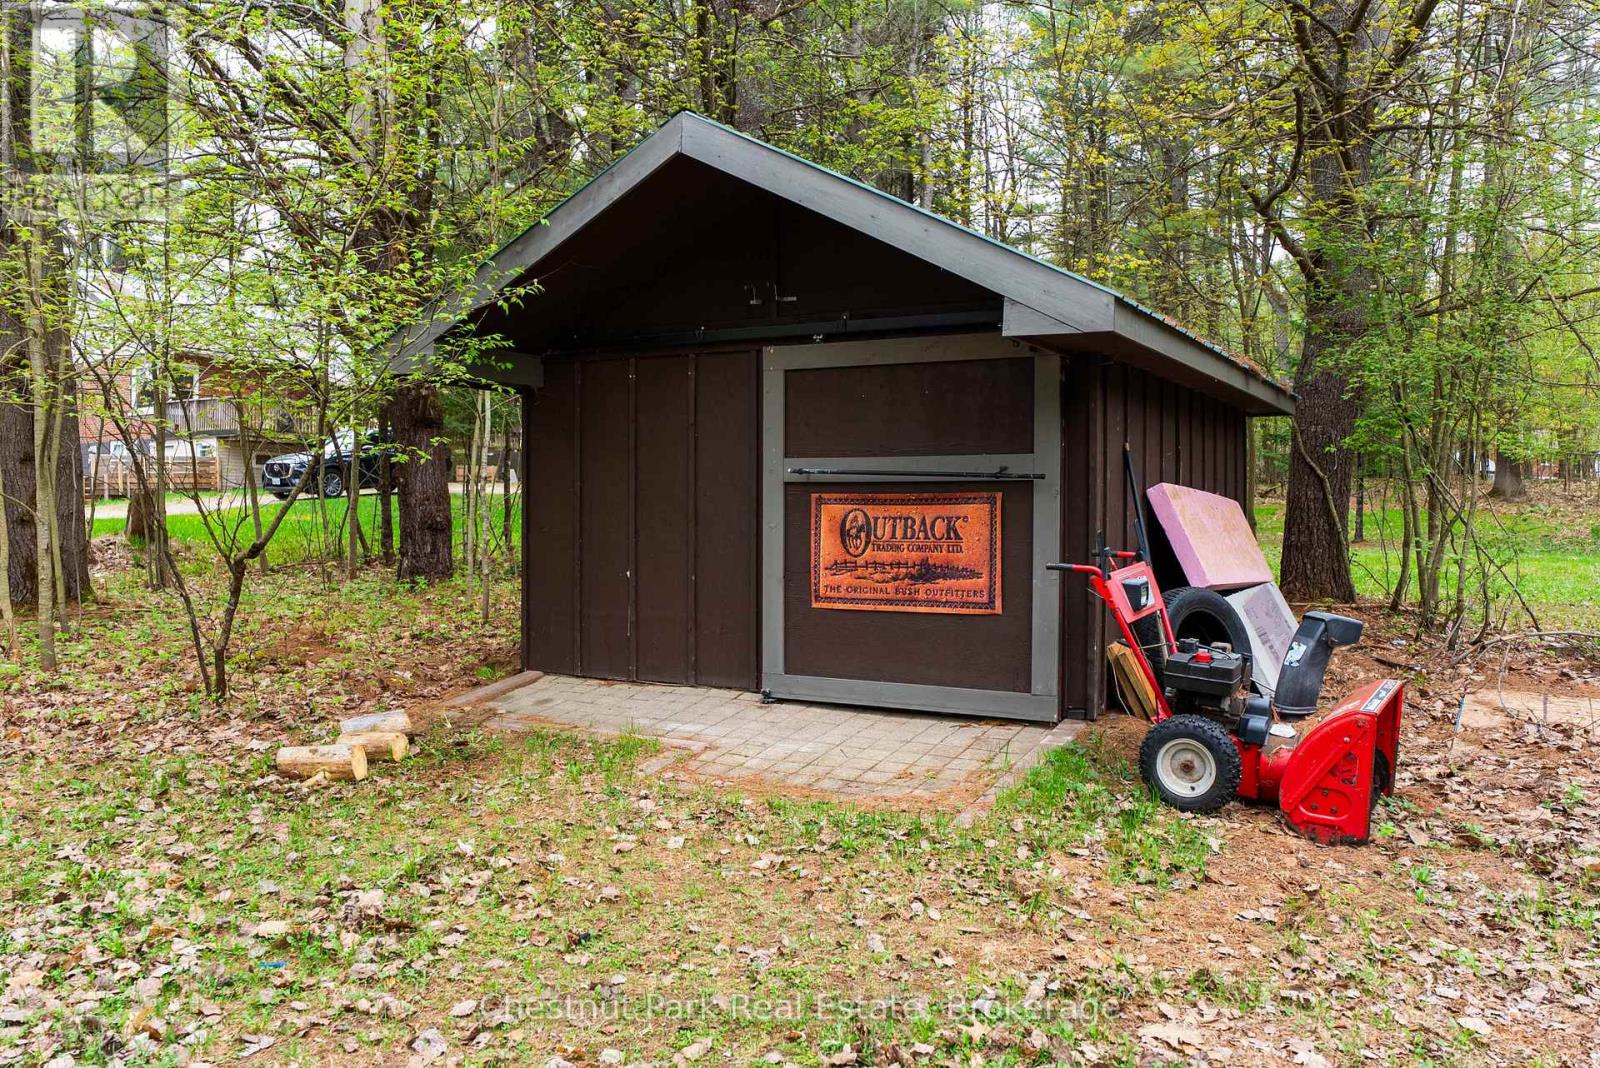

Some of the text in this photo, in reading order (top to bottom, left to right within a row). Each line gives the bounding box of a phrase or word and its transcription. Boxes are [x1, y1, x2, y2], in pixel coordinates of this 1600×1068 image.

[872, 543, 905, 553] TRADING
[907, 543, 945, 554] COMPANY
[824, 585, 986, 599] THE ORIGINAL BUSH OUTFITTERS
